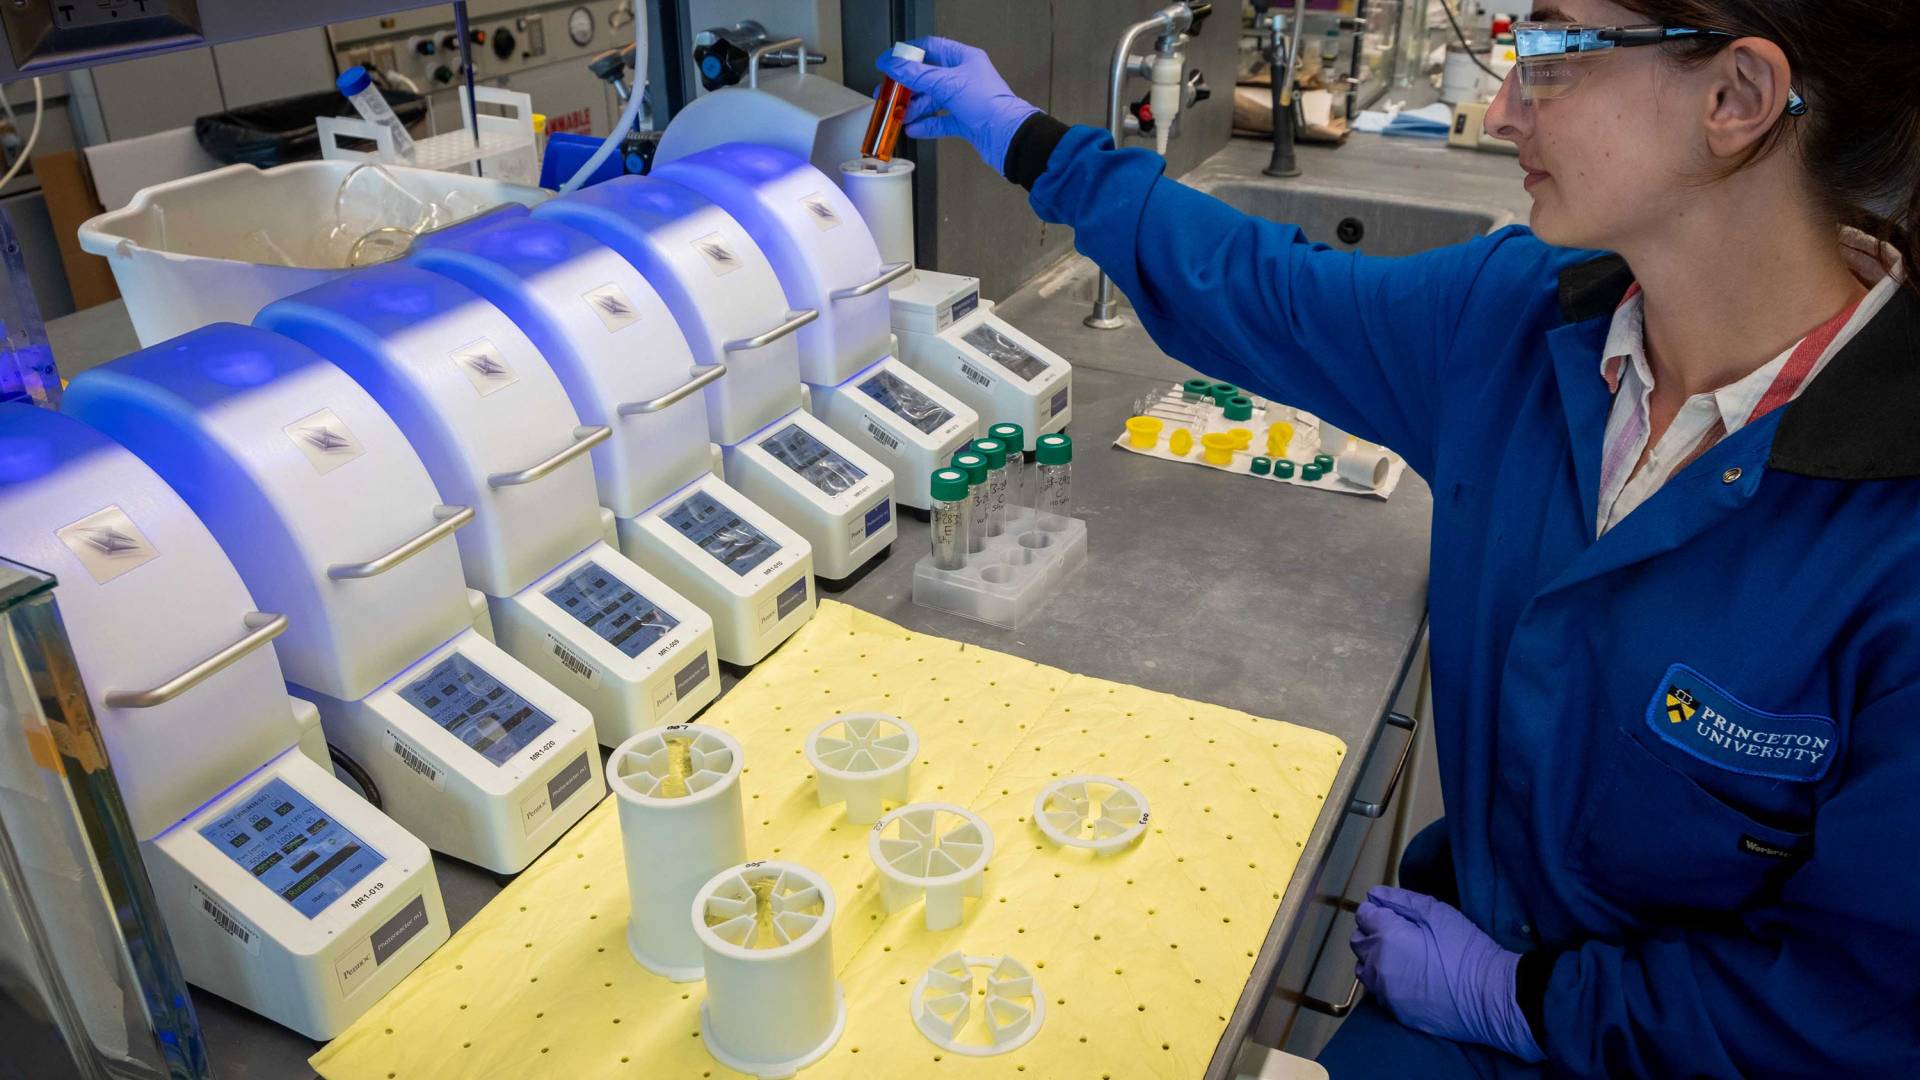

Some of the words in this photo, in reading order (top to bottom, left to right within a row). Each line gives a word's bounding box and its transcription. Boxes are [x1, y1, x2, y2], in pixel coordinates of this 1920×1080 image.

[1697, 721, 1824, 764] UNIVERSITY
[1700, 705, 1830, 750] PRINCETON
[529, 740, 556, 762] MR1-020
[224, 828, 239, 839] 12
[246, 813, 261, 824] 00
[268, 797, 283, 809] 00
[246, 848, 270, 866] 5000
[275, 830, 296, 846] 1000
[286, 871, 321, 898] Running
[351, 882, 384, 910] MR1-019
